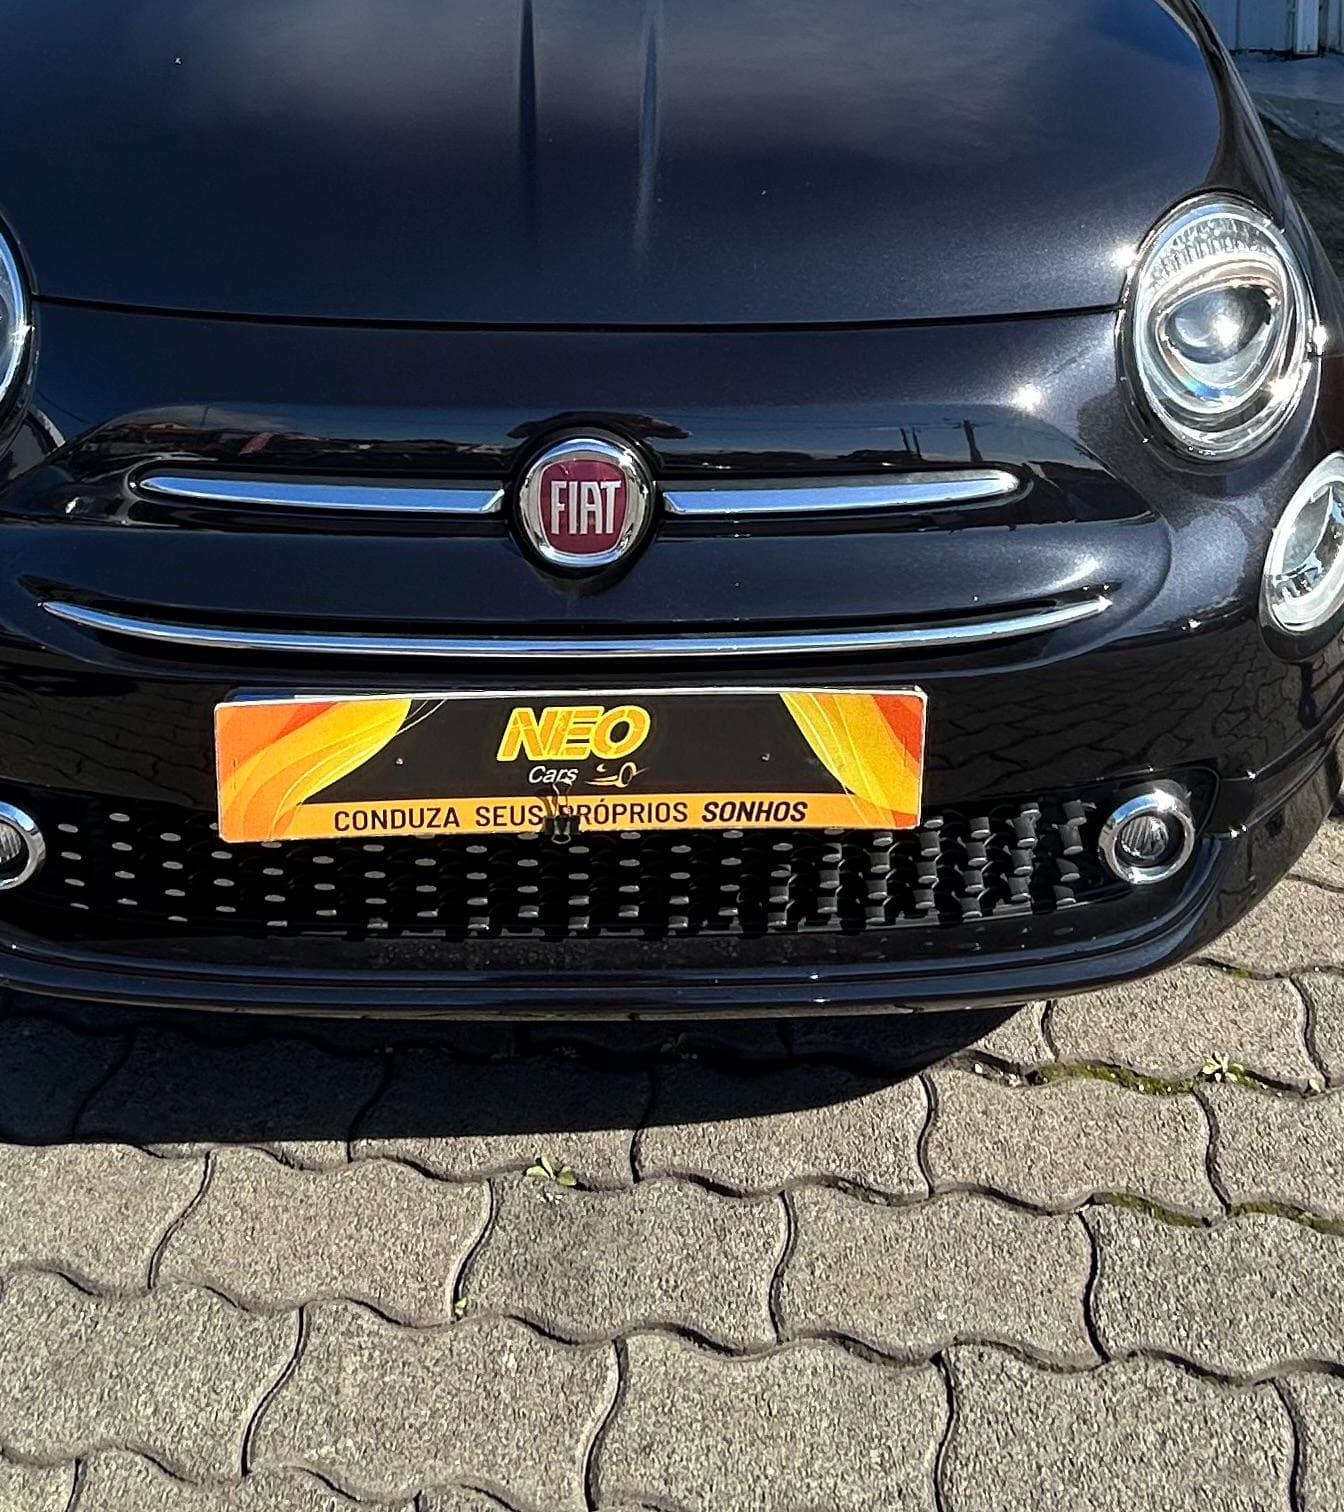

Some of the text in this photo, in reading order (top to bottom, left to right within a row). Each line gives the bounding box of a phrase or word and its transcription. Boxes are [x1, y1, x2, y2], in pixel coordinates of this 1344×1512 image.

[551, 480, 622, 535] FIAT
[496, 705, 651, 761] NEO
[528, 765, 579, 784] Cars
[334, 806, 461, 831] CONDUZA
[475, 804, 544, 827] SEUS
[702, 801, 809, 822] SONHOS
